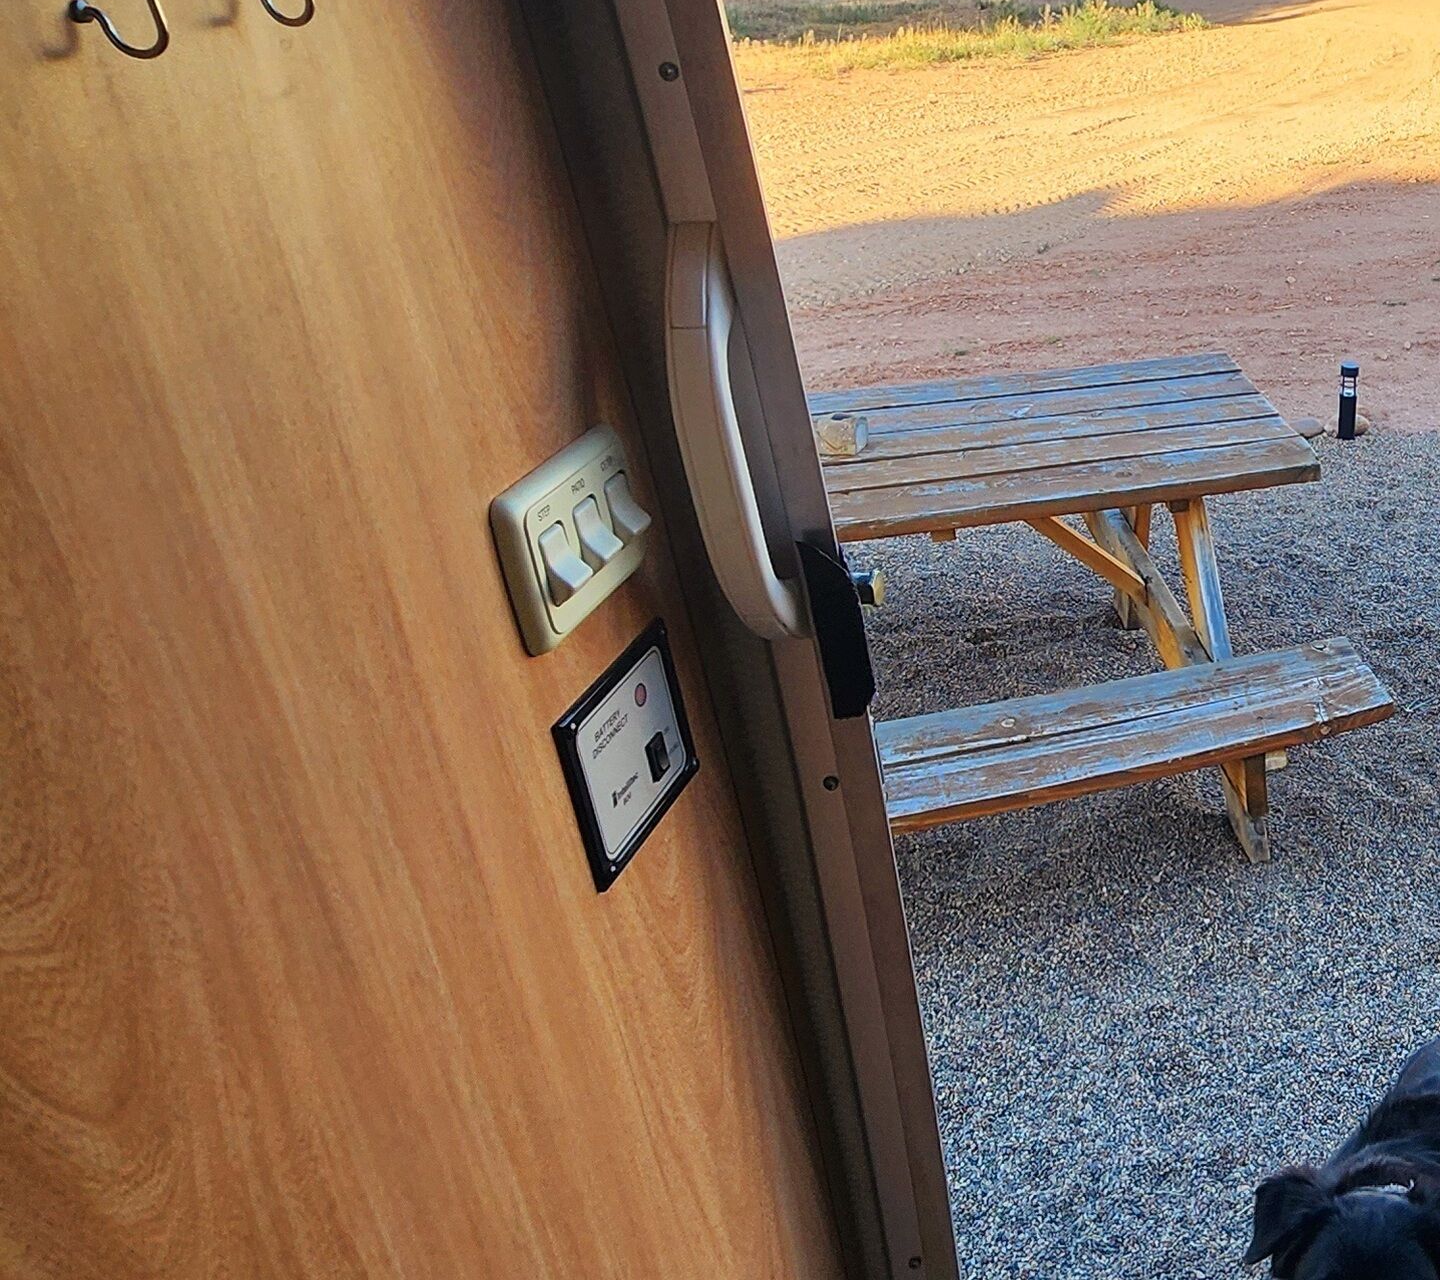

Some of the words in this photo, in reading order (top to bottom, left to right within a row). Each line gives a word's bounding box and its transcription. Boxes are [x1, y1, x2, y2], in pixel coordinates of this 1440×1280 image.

[538, 504, 550, 521] STEP
[592, 713, 629, 759] DISCONNECT
[594, 709, 621, 743] BATTERY
